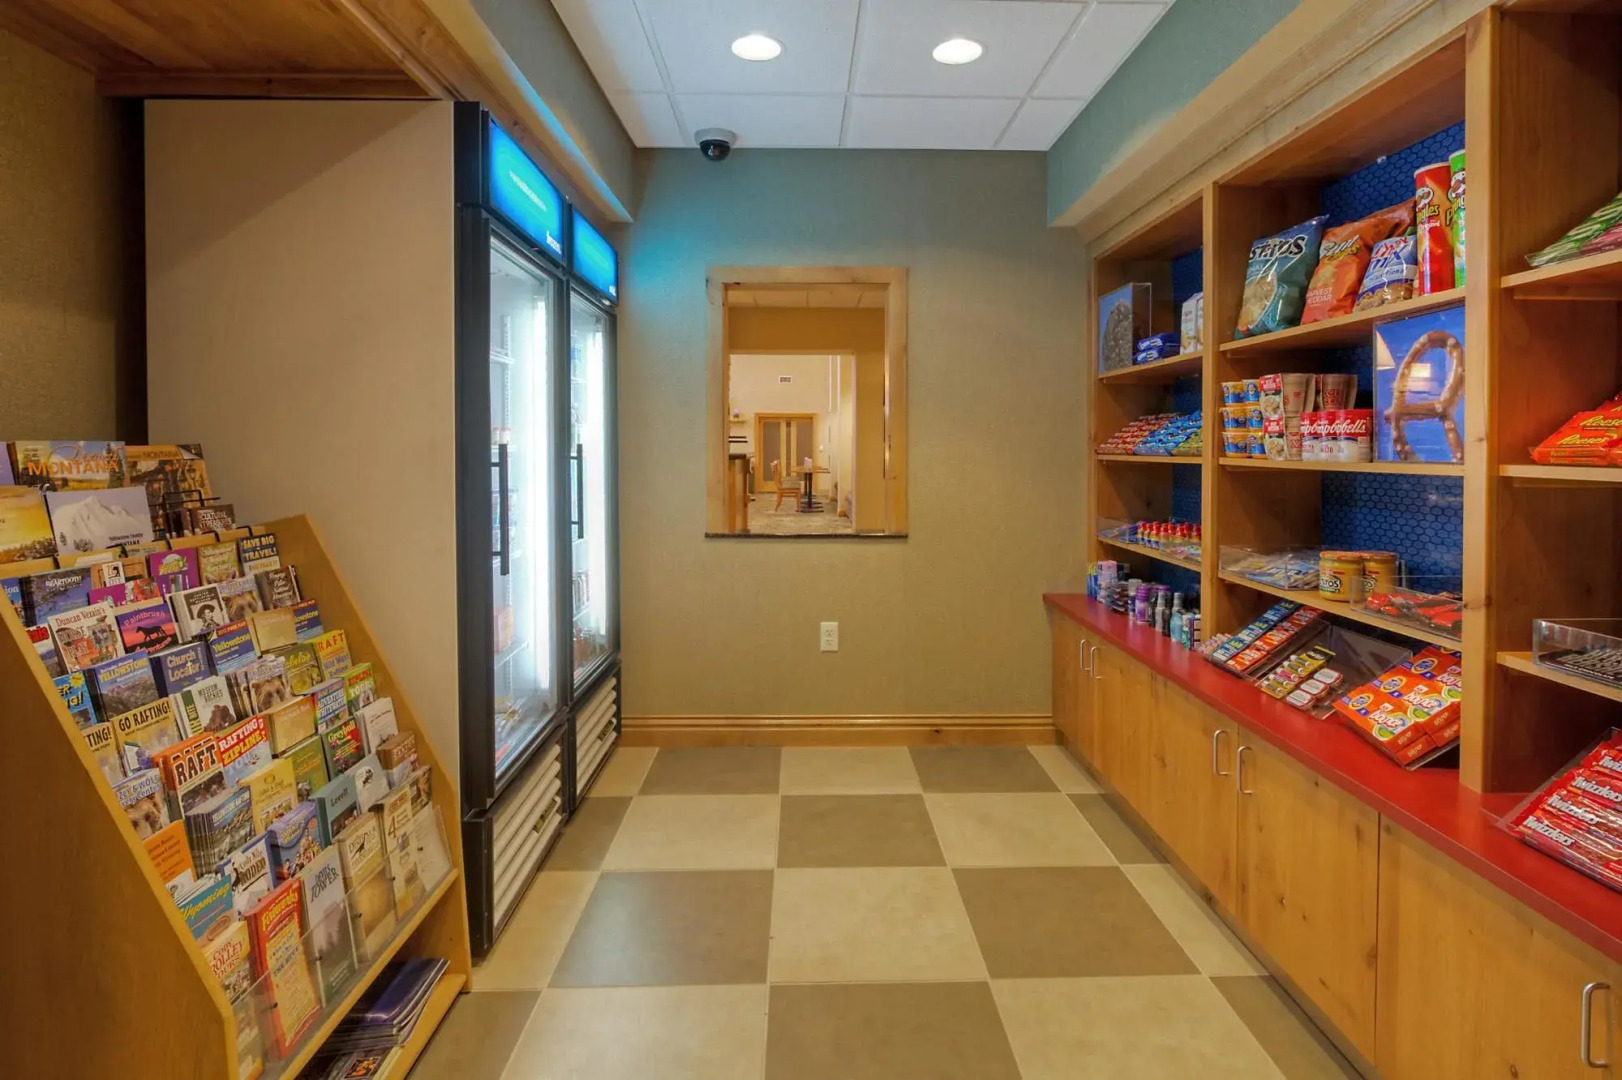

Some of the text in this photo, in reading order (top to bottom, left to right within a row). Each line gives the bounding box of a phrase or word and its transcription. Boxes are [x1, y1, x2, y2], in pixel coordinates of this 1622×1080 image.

[28, 460, 119, 476] MONTANA
[55, 606, 106, 628] Duncan Vezain's
[123, 610, 166, 627] Paintbrush
[317, 632, 345, 652] RAFT
[167, 649, 197, 667] Church
[119, 717, 131, 732] GO
[133, 700, 171, 726] RAFTING!
[327, 719, 357, 743] Greybull
[218, 718, 258, 752] RAFTING
[222, 731, 262, 766] ZIPLINE
[175, 742, 217, 787] RAFT
[1547, 794, 1600, 825] Twizzlers
[1522, 815, 1576, 846] Twizzlers
[311, 867, 340, 903] TOWER
[181, 883, 230, 920] Wyoming
[212, 940, 243, 976] ROLLEY
[213, 941, 232, 961] CODY
